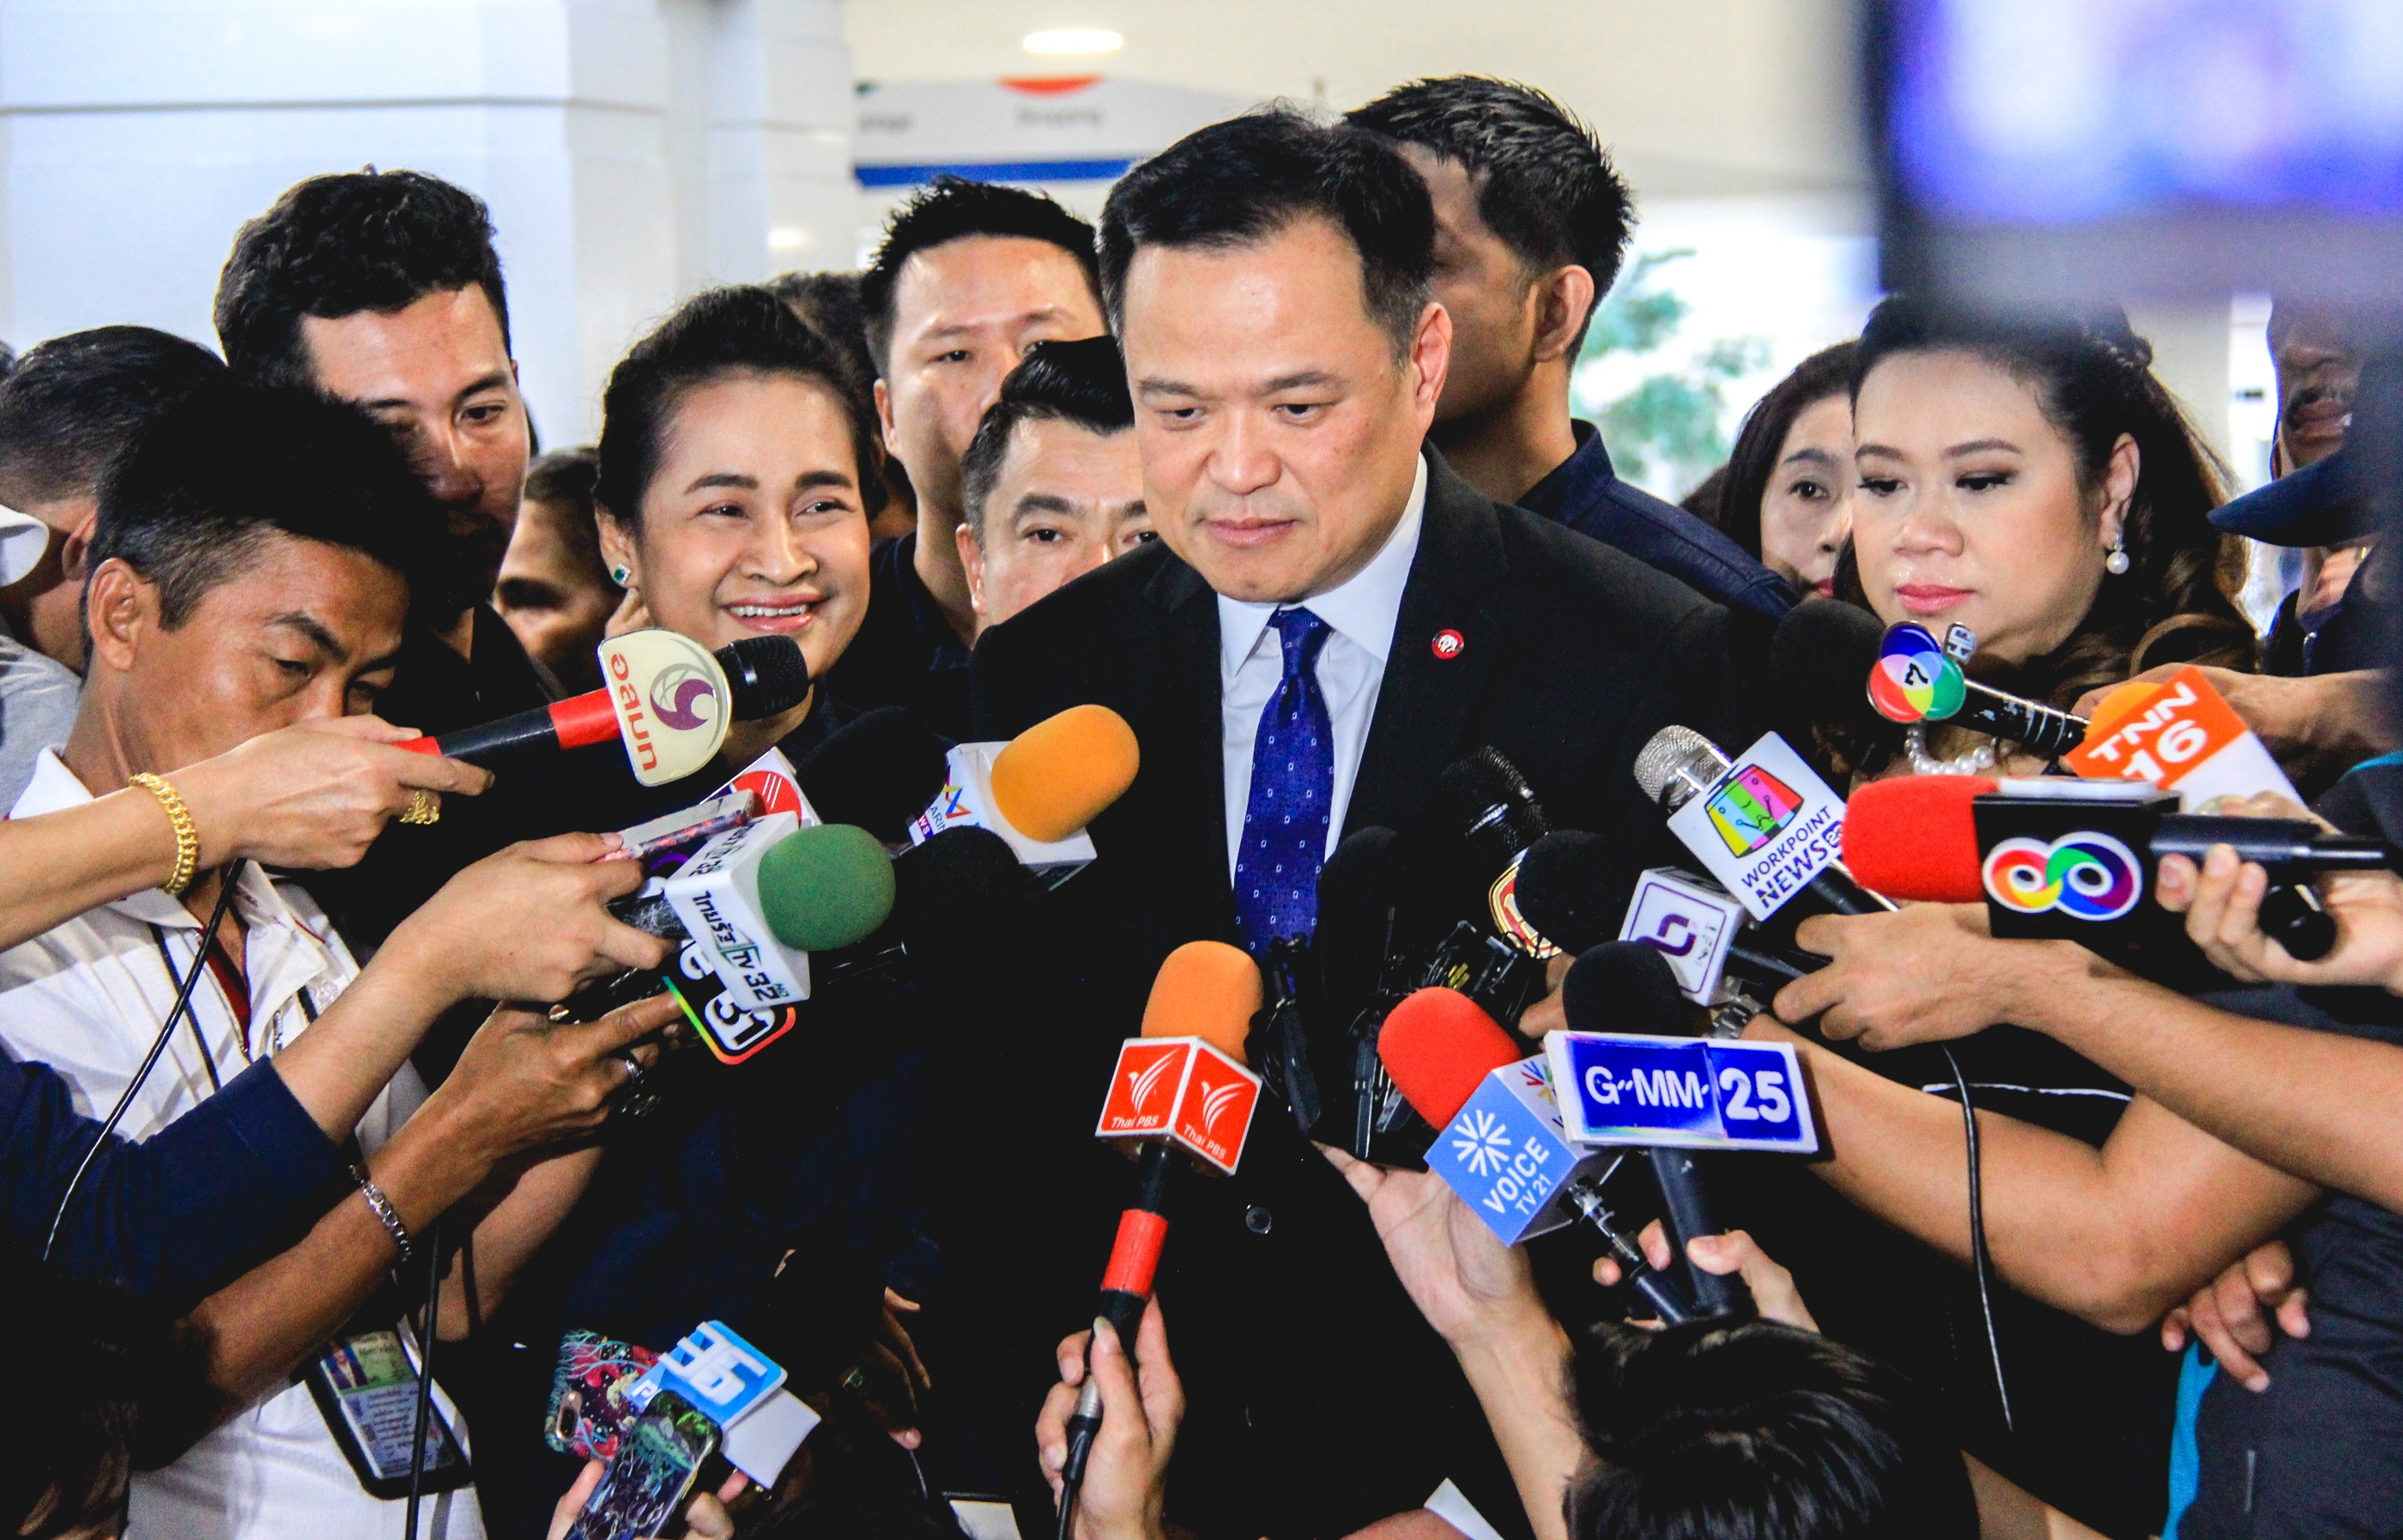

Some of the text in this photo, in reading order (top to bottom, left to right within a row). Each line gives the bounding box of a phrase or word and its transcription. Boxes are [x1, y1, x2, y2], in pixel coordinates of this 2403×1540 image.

[1904, 662, 1928, 685] 7
[2087, 681, 2198, 762] TNN
[2122, 719, 2207, 782] 16
[1741, 805, 1832, 889] WORKPOINT
[1755, 838, 1828, 909] NEWS
[693, 890, 736, 943] ไทยรัฐ
[732, 950, 755, 969] TV
[743, 972, 780, 1001] 32
[1720, 1067, 1792, 1123] 25
[1111, 1115, 1159, 1129] Thai PBS
[1183, 1124, 1227, 1160] Thai PBS
[1483, 1135, 1550, 1216] VOICE
[1515, 1175, 1553, 1217] TV 21
